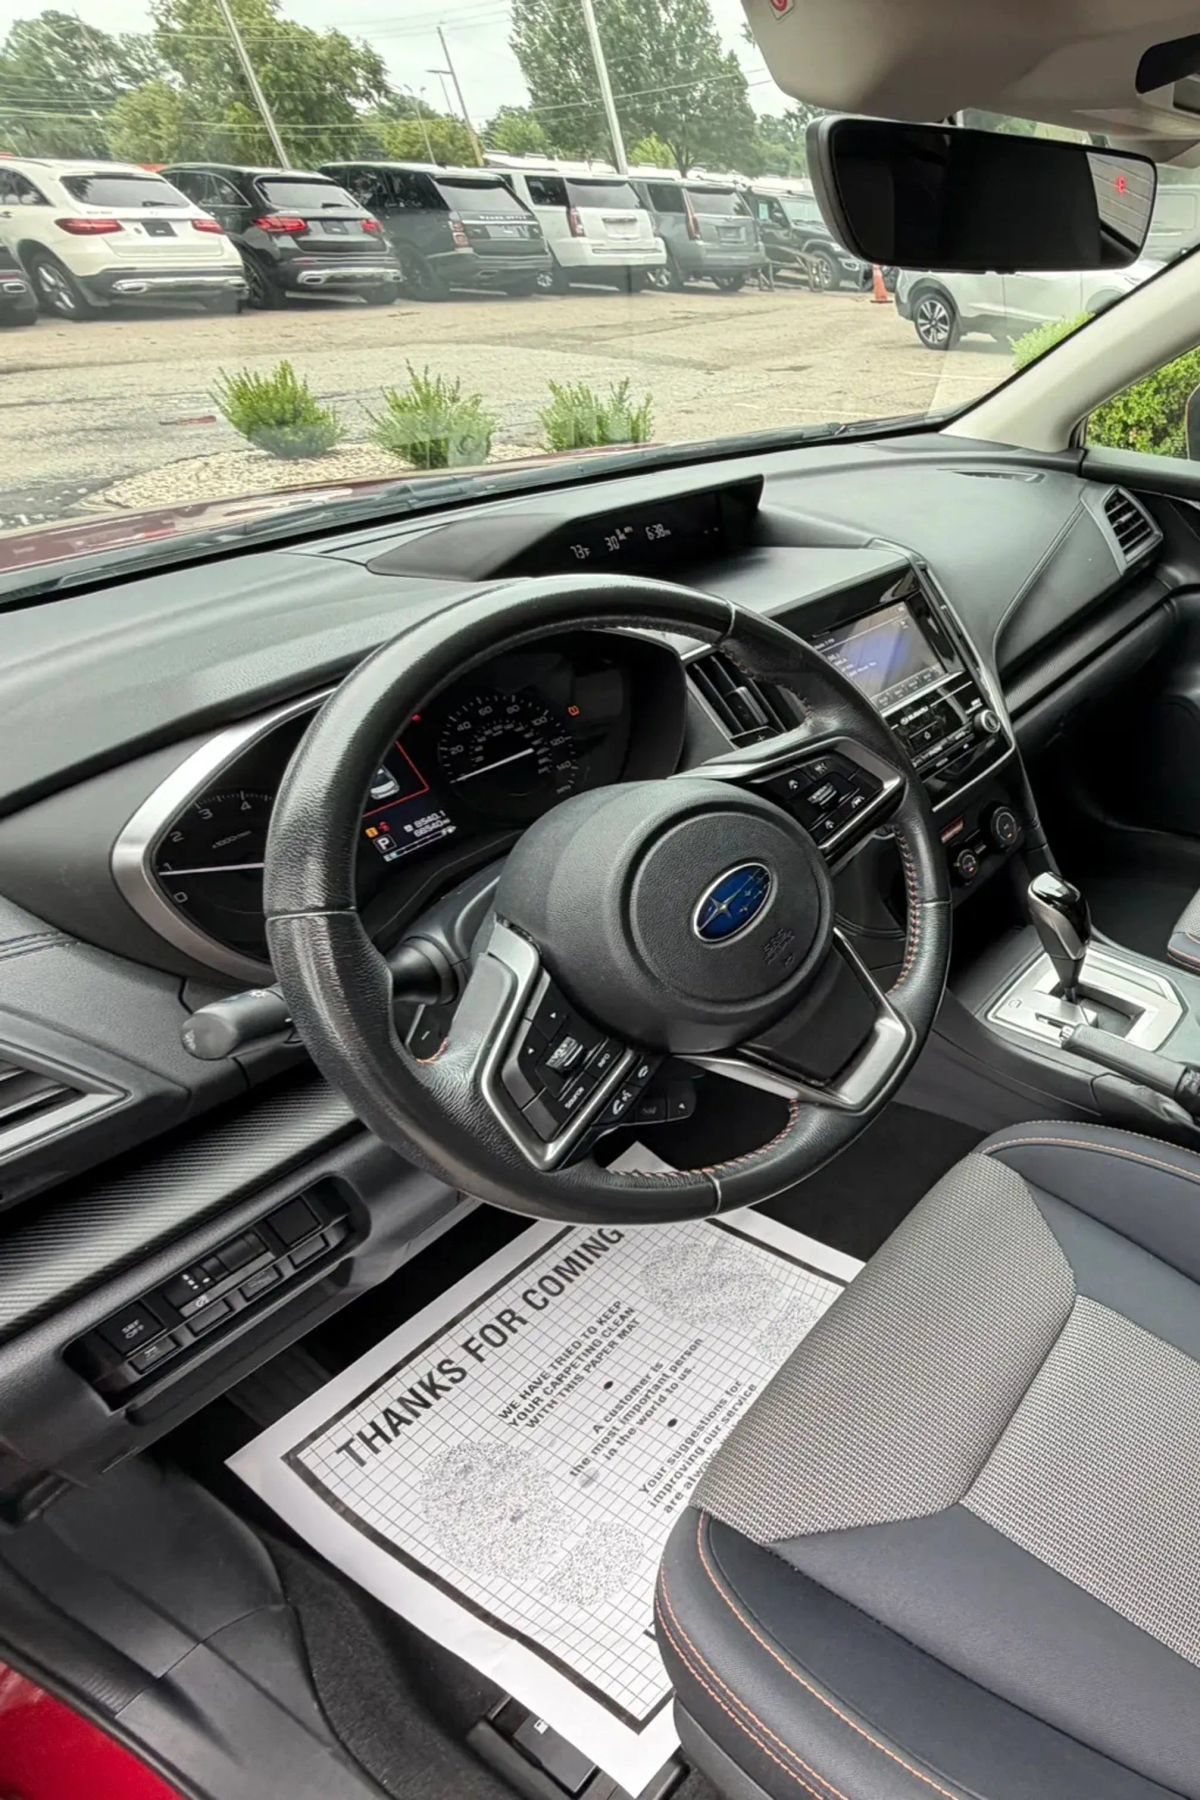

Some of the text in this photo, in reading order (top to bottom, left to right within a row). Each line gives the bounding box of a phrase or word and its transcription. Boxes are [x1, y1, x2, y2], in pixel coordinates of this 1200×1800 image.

[457, 721, 472, 732] 40
[170, 830, 185, 842] 2
[198, 808, 213, 820] 3
[240, 801, 252, 811] 4
[377, 837, 390, 850] P
[173, 891, 188, 904] 0
[335, 1227, 625, 1468] THANKS FOR COMING
[498, 1300, 623, 1420] WE HAVE TRIED TO KEEP
[509, 1306, 636, 1428] YOUR CARPETING CLEAN
[525, 1318, 640, 1429] WITH THIS PAPER MAT
[569, 1338, 703, 1477] the most important person
[593, 1361, 664, 1434] A customer is
[602, 1446, 618, 1461] in
[616, 1427, 637, 1446] the
[636, 1394, 668, 1426] world
[665, 1381, 679, 1395] to
[639, 1465, 668, 1494] Your
[666, 1398, 728, 1466] suggestions
[724, 1381, 742, 1397] for
[648, 1446, 705, 1508] improving
[703, 1424, 722, 1445] our
[721, 1383, 758, 1424] service
[663, 1491, 684, 1513] are
